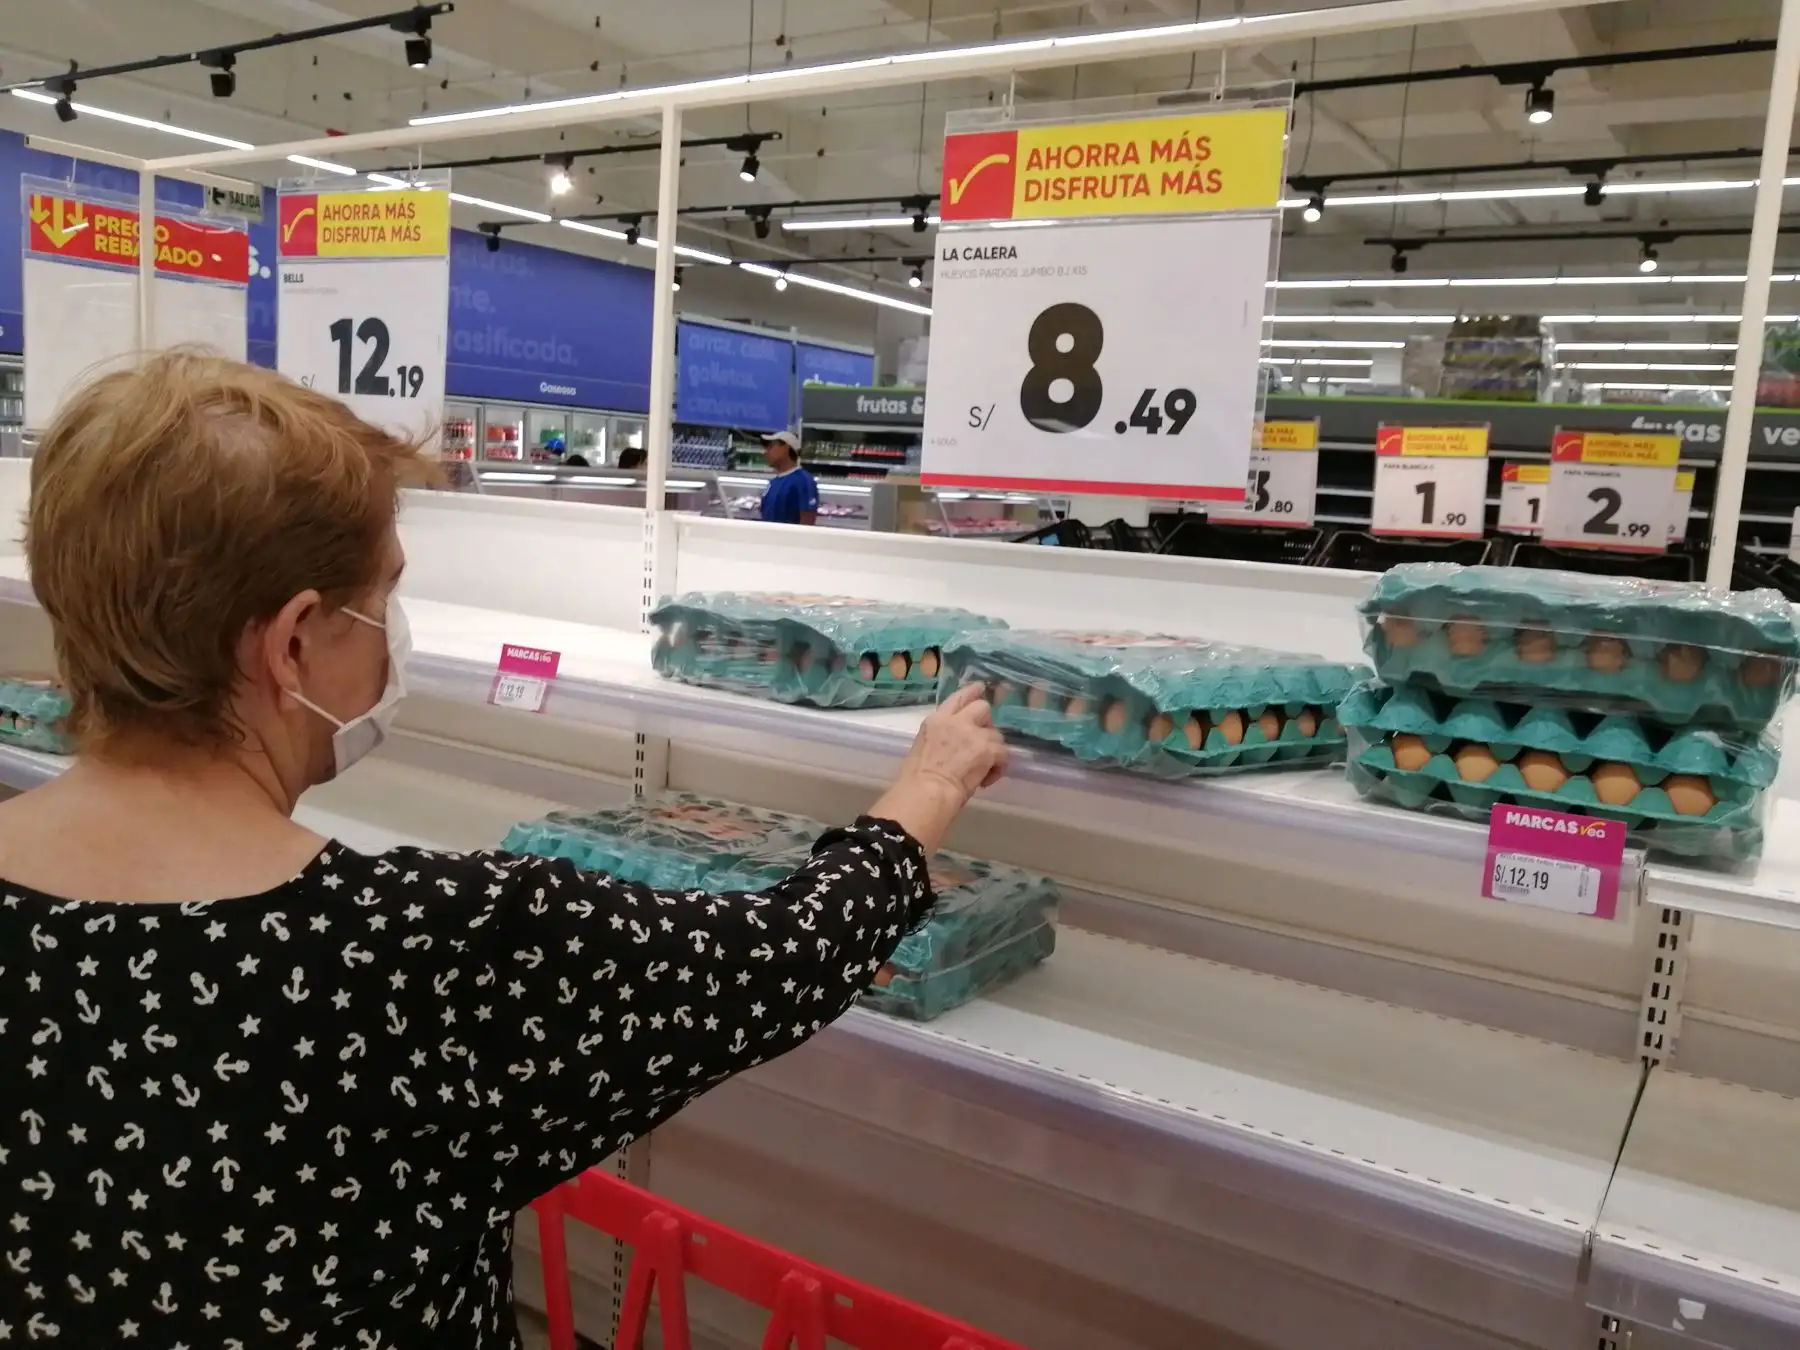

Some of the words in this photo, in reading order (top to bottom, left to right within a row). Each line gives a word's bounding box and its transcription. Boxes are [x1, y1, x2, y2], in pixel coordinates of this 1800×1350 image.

[1026, 141, 1140, 171] AHORRA
[1150, 130, 1212, 163] MÁS
[1024, 173, 1151, 202] DISFRUTA
[1161, 164, 1223, 196] MÁS
[229, 190, 261, 208] SALIDA
[322, 203, 381, 221] AHORRA
[385, 198, 416, 220] MÁS
[94, 214, 170, 243] PRECO
[323, 226, 386, 244] DISFRUTA
[391, 221, 422, 242] MÁS
[942, 248, 959, 261] LA
[963, 246, 1018, 260] CALERA
[283, 273, 305, 284] BELLS
[941, 268, 977, 280] HUEVOS
[979, 267, 1018, 279] PARDOS
[1020, 266, 1056, 278] JUMBO
[330, 317, 424, 398] 12.19
[857, 395, 908, 414] frutas
[968, 403, 996, 431] S/
[1583, 487, 1650, 538] 2.99
[507, 647, 540, 662] MARCAS
[1505, 811, 1578, 835] MARCAS
